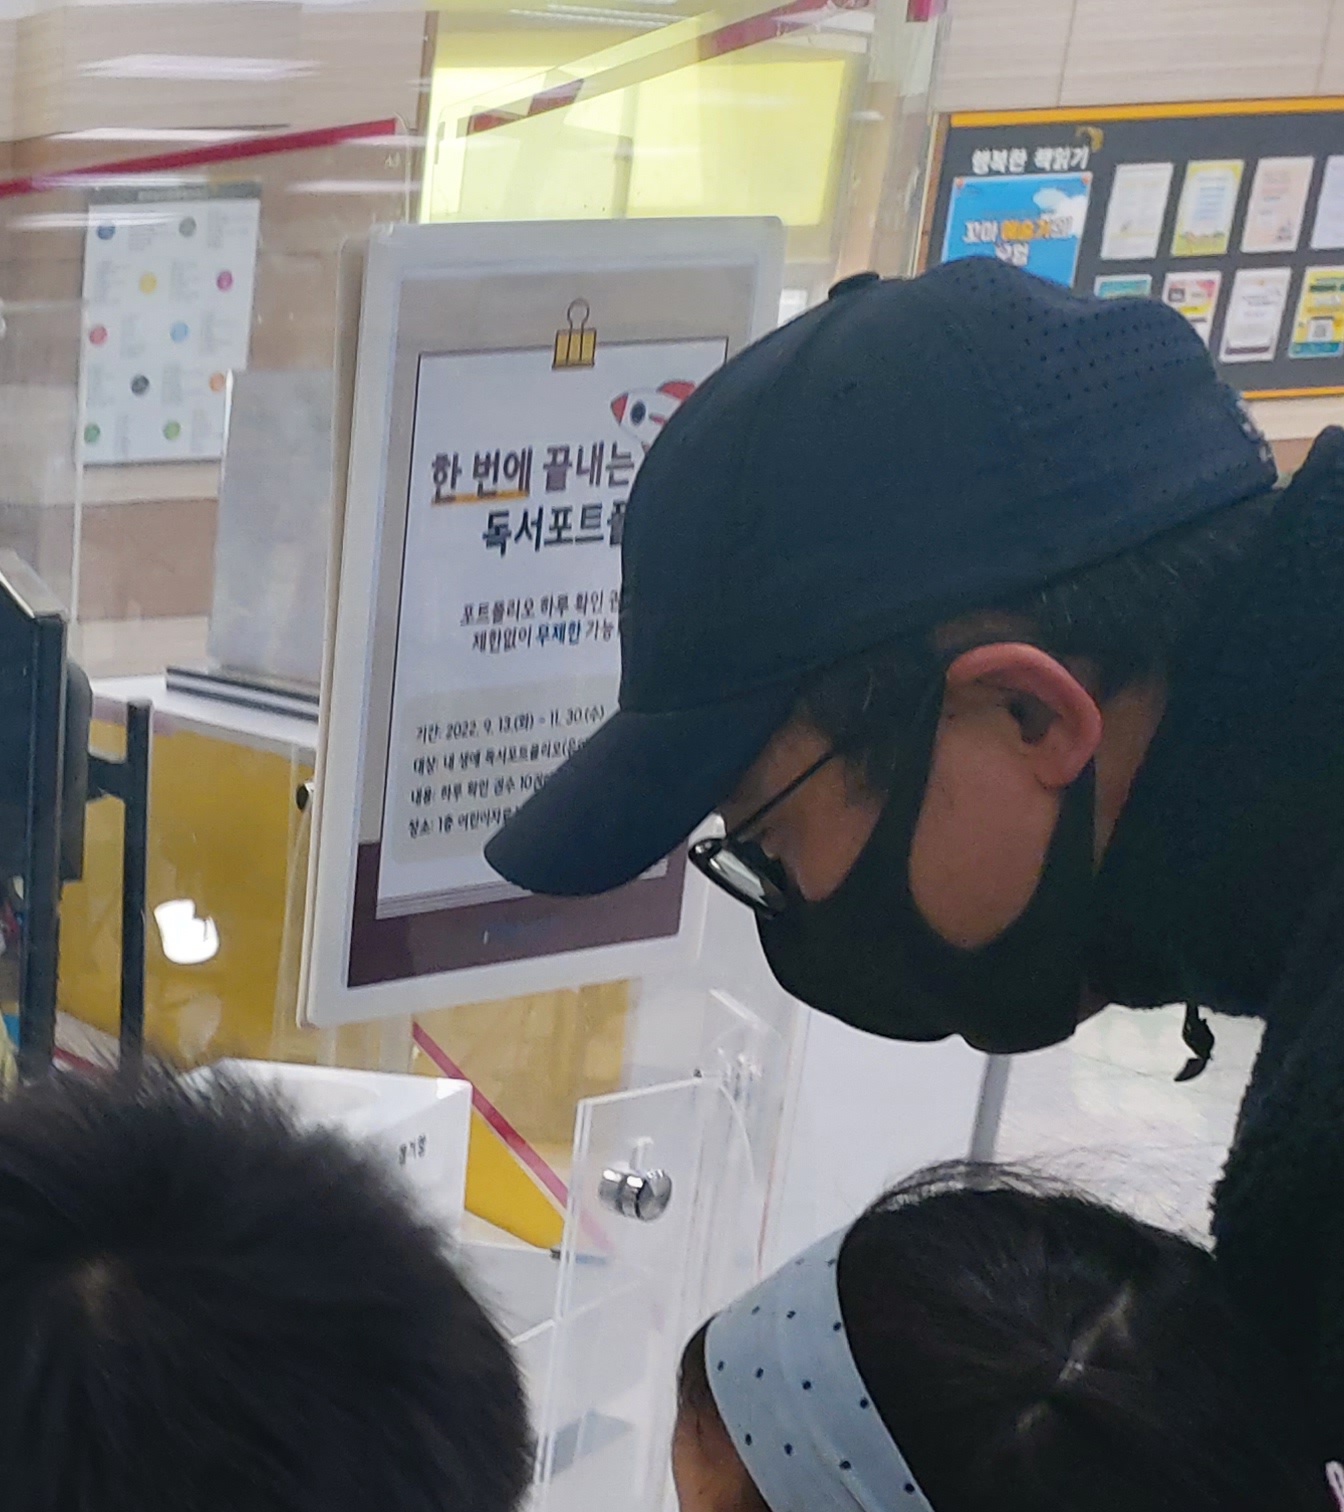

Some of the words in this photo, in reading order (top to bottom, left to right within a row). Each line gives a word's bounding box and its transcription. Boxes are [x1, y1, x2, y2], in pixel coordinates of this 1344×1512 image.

[431, 452, 462, 504] 한
[472, 446, 533, 499] 번에
[543, 440, 634, 493] 끝내는
[460, 597, 535, 626] 포트폴리오
[540, 592, 569, 618] 하루
[576, 588, 604, 616] 확인
[472, 624, 532, 653] 제한없이
[536, 619, 581, 647] 무제한
